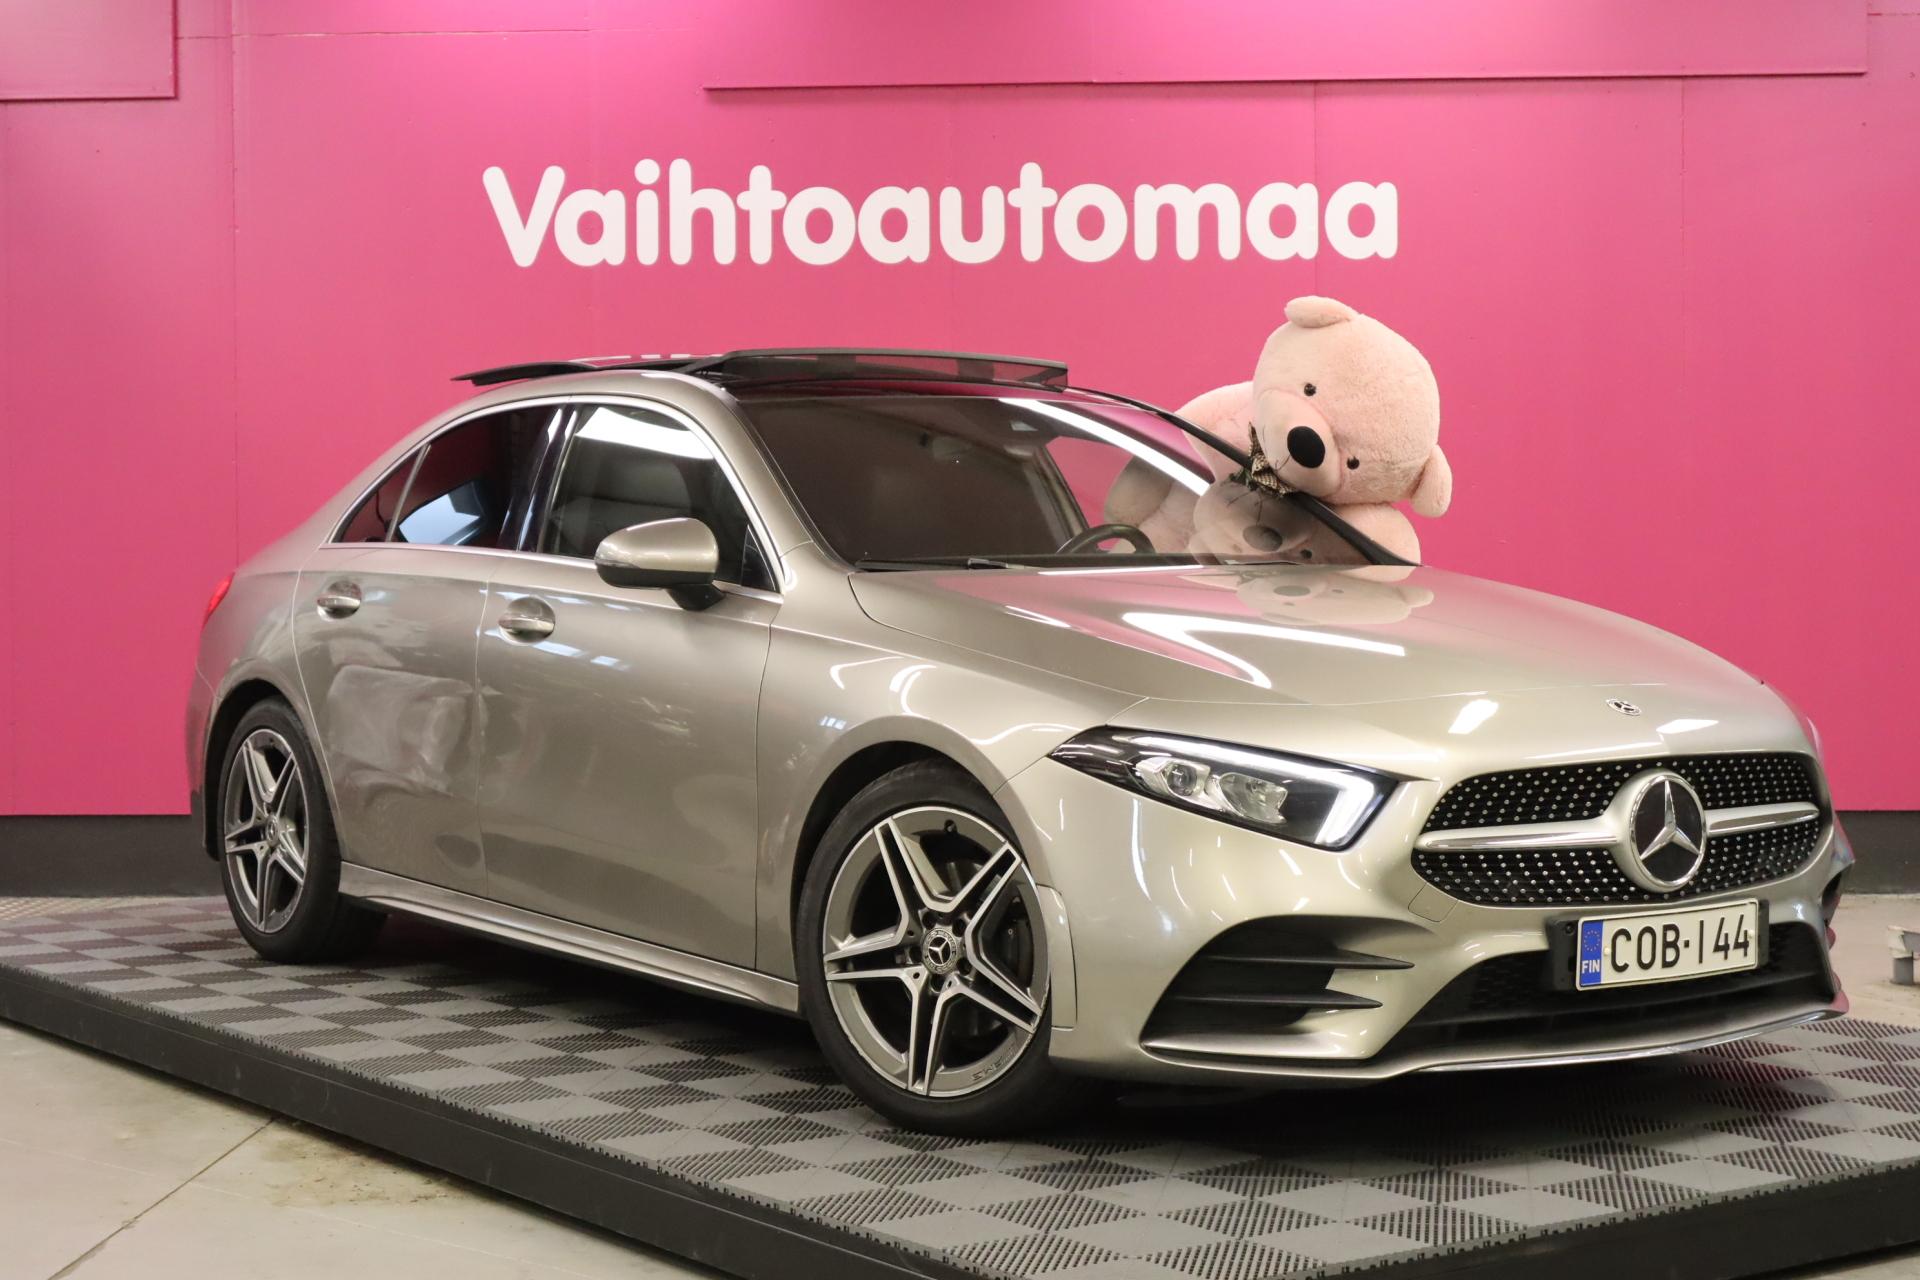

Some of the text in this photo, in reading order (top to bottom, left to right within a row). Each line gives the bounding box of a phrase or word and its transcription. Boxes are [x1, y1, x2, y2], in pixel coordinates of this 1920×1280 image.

[482, 158, 1399, 267] Vaihtoautomaa
[1581, 958, 1601, 975] FIN
[1610, 914, 1750, 973] COB-144
